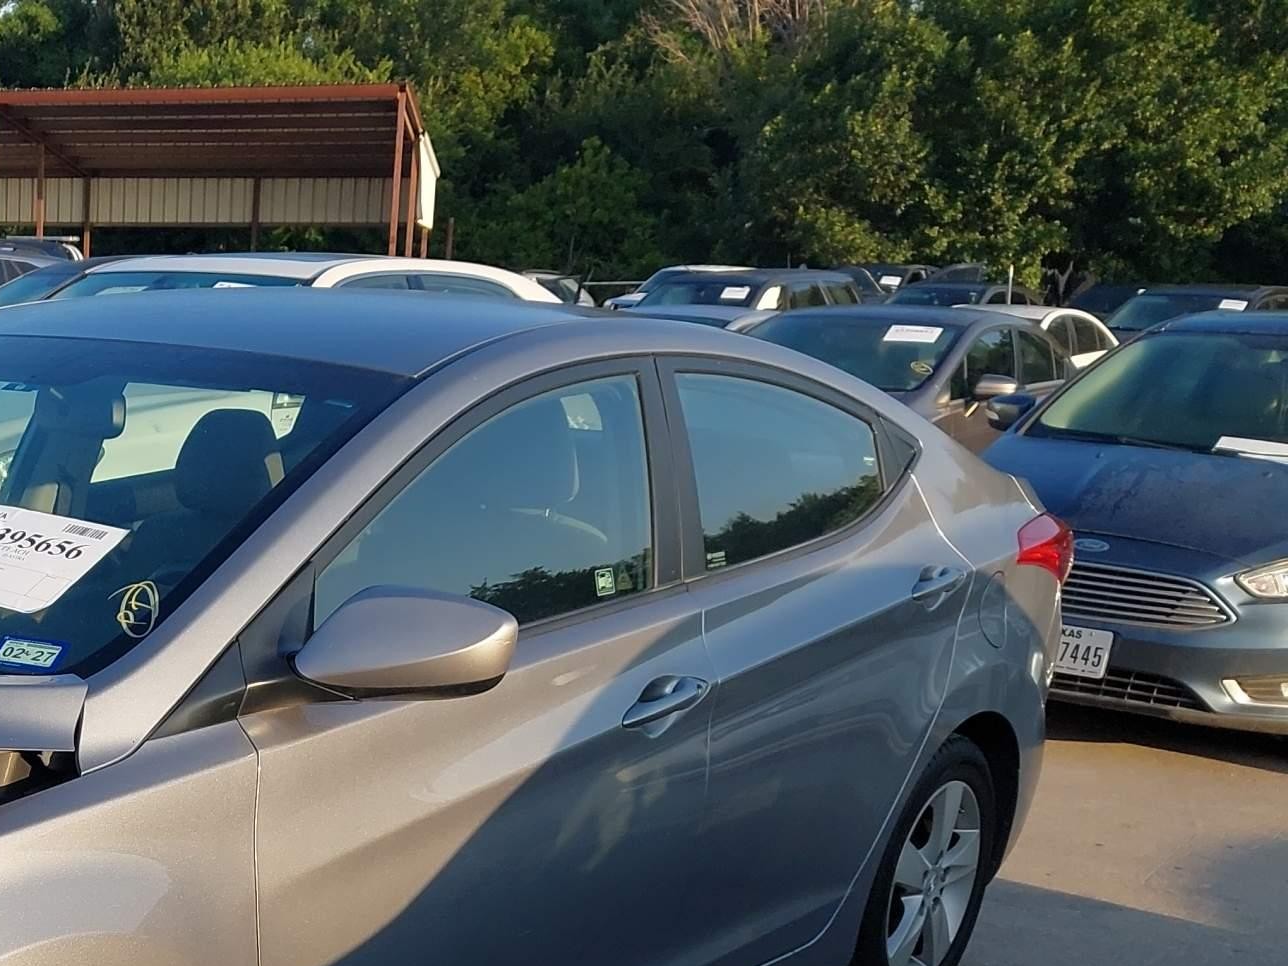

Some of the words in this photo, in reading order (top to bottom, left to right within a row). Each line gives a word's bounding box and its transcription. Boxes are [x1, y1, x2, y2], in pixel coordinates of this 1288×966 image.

[1062, 628, 1083, 640] XAS
[2, 646, 25, 659] 02
[30, 650, 57, 663] 27
[1059, 641, 1103, 667] 7445
